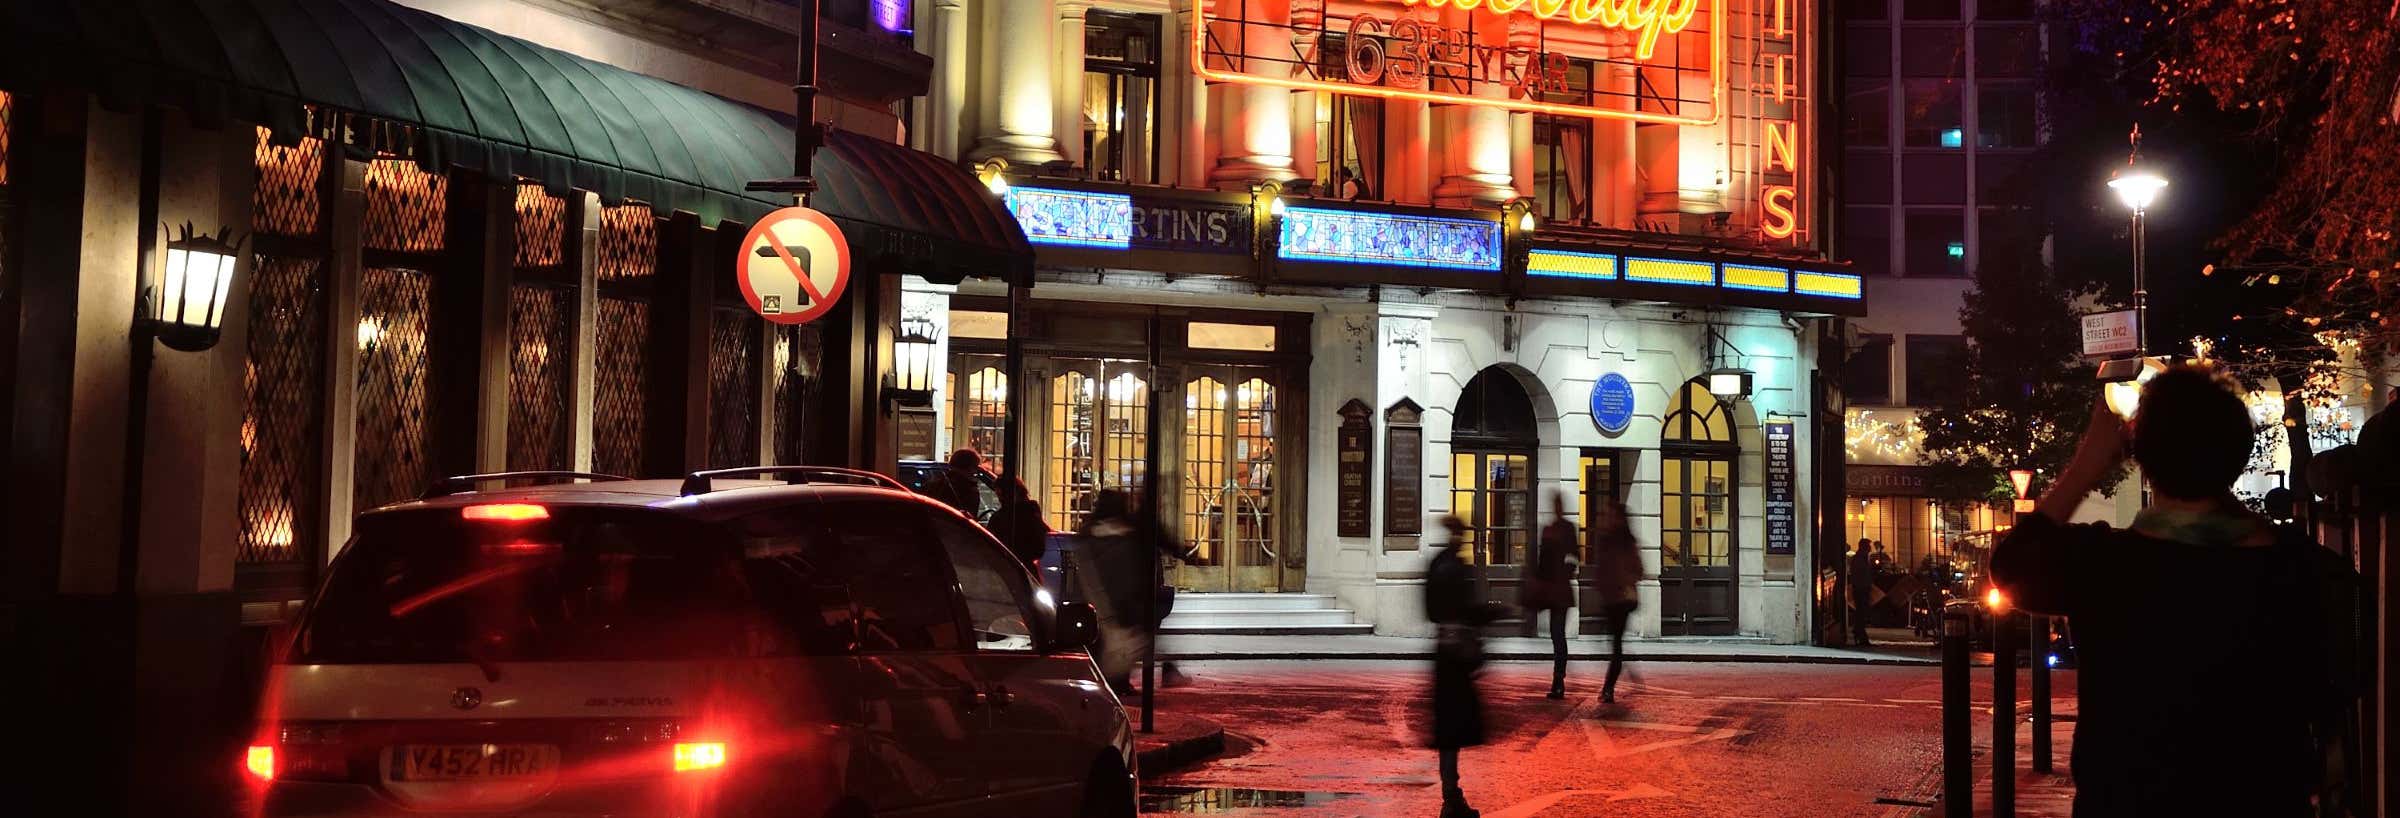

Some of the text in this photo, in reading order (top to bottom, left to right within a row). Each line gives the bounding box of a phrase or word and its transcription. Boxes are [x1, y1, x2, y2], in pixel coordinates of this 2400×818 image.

[1474, 43, 1569, 94] YEAR
[2086, 317, 2104, 328] WEST
[2086, 326, 2127, 340] STREET WC2
[1847, 470, 1921, 487] Cantina
[412, 747, 479, 776] Y452
